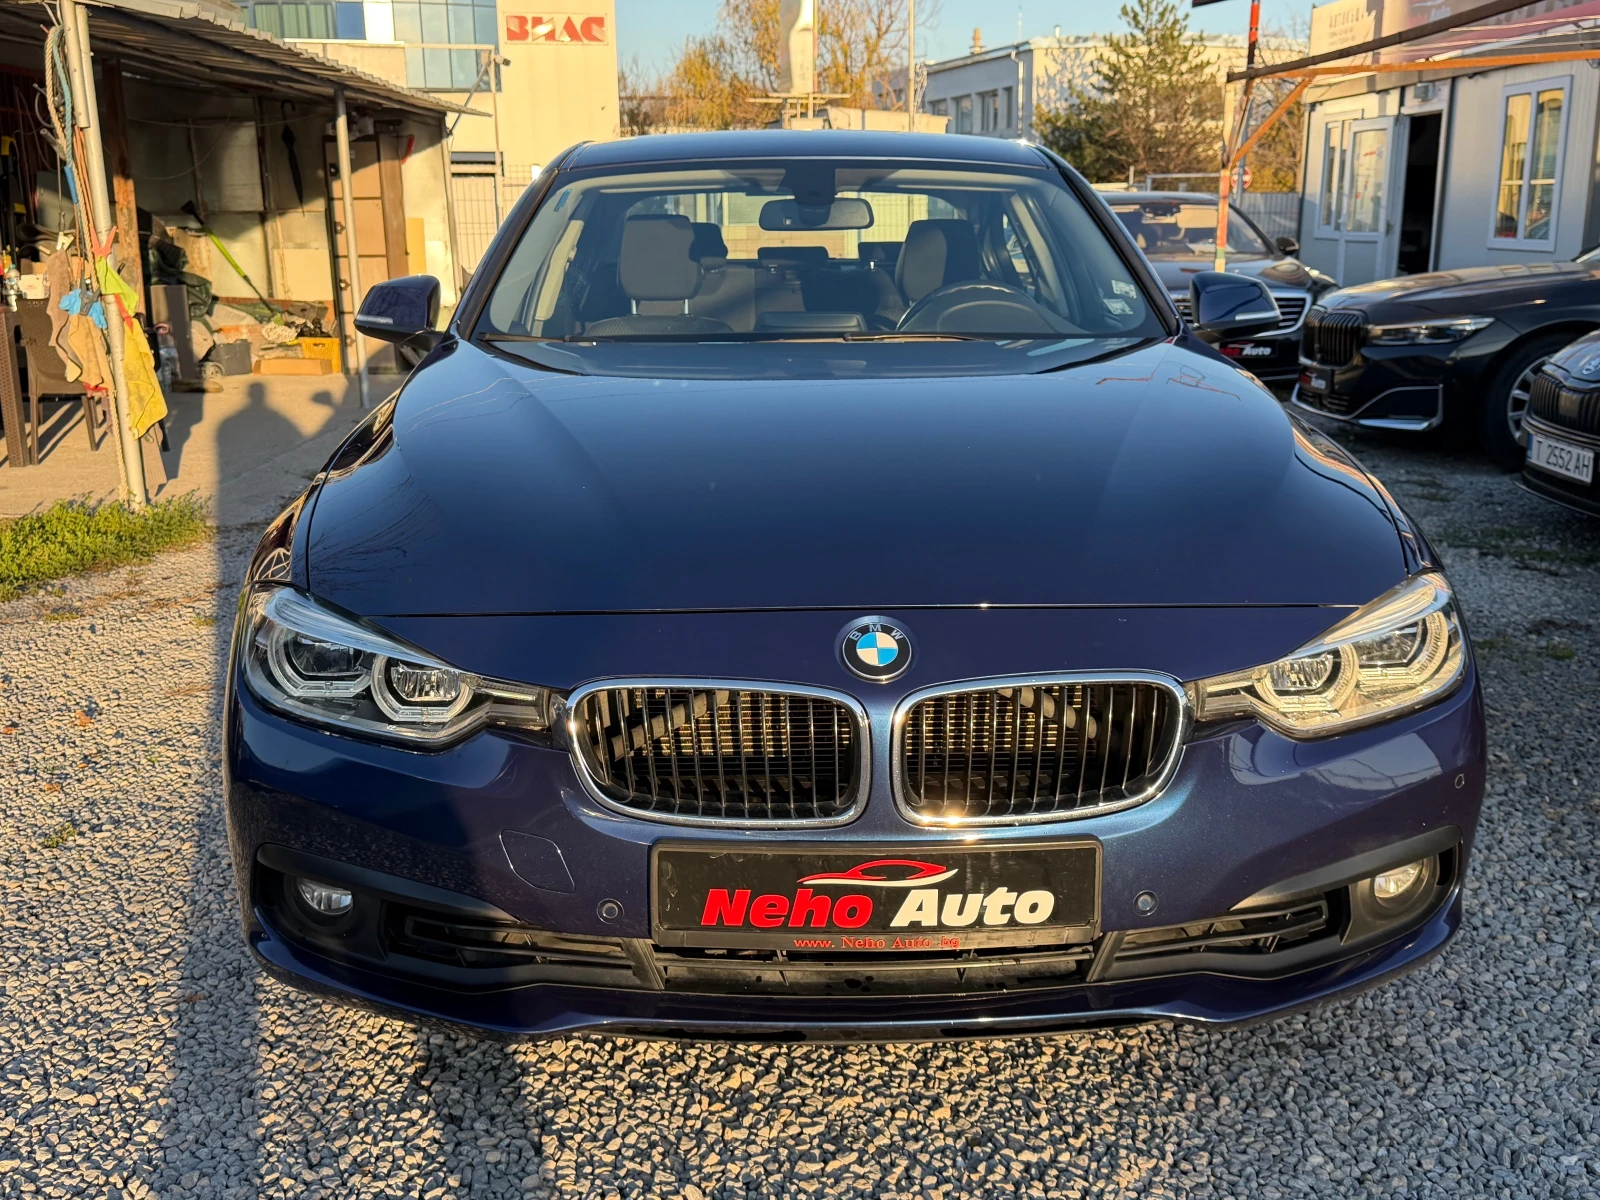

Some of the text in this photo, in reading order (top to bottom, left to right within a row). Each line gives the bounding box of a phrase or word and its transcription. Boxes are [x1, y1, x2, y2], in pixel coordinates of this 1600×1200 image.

[1546, 444, 1573, 472] 2552
[1574, 452, 1592, 478] AH
[849, 623, 904, 642] BMW
[700, 886, 1055, 928] Neho Auto
[840, 935, 887, 949] Neho
[890, 936, 933, 949] Auto
